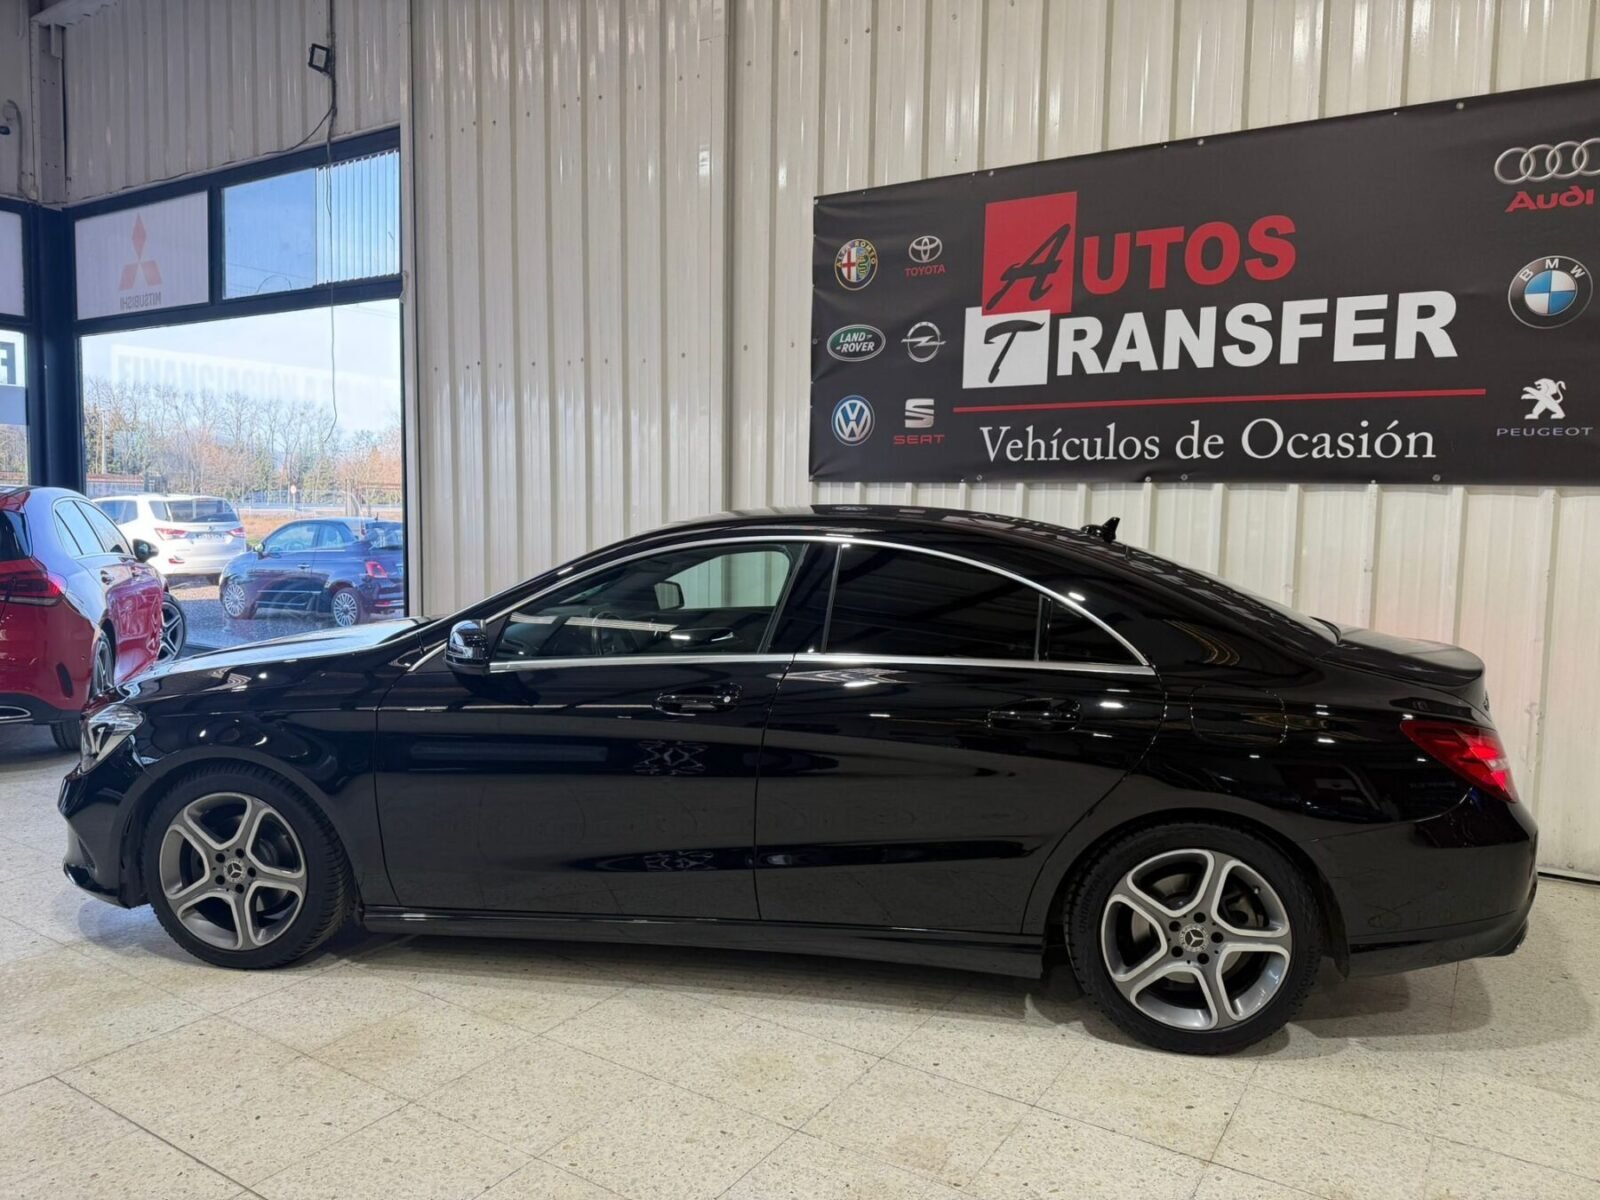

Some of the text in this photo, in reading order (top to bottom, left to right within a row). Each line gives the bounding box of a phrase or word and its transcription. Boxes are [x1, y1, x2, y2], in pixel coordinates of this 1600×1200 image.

[1505, 185, 1595, 213] Audi
[905, 264, 946, 277] TOYOTA
[985, 214, 1297, 311] AUTOS
[1519, 258, 1586, 282] BMW
[984, 290, 1458, 384] TRANSFER
[893, 434, 945, 445] SEAT
[980, 417, 1436, 462] Vehículos de Ocasión
[1496, 427, 1593, 437] PEUGEOT
